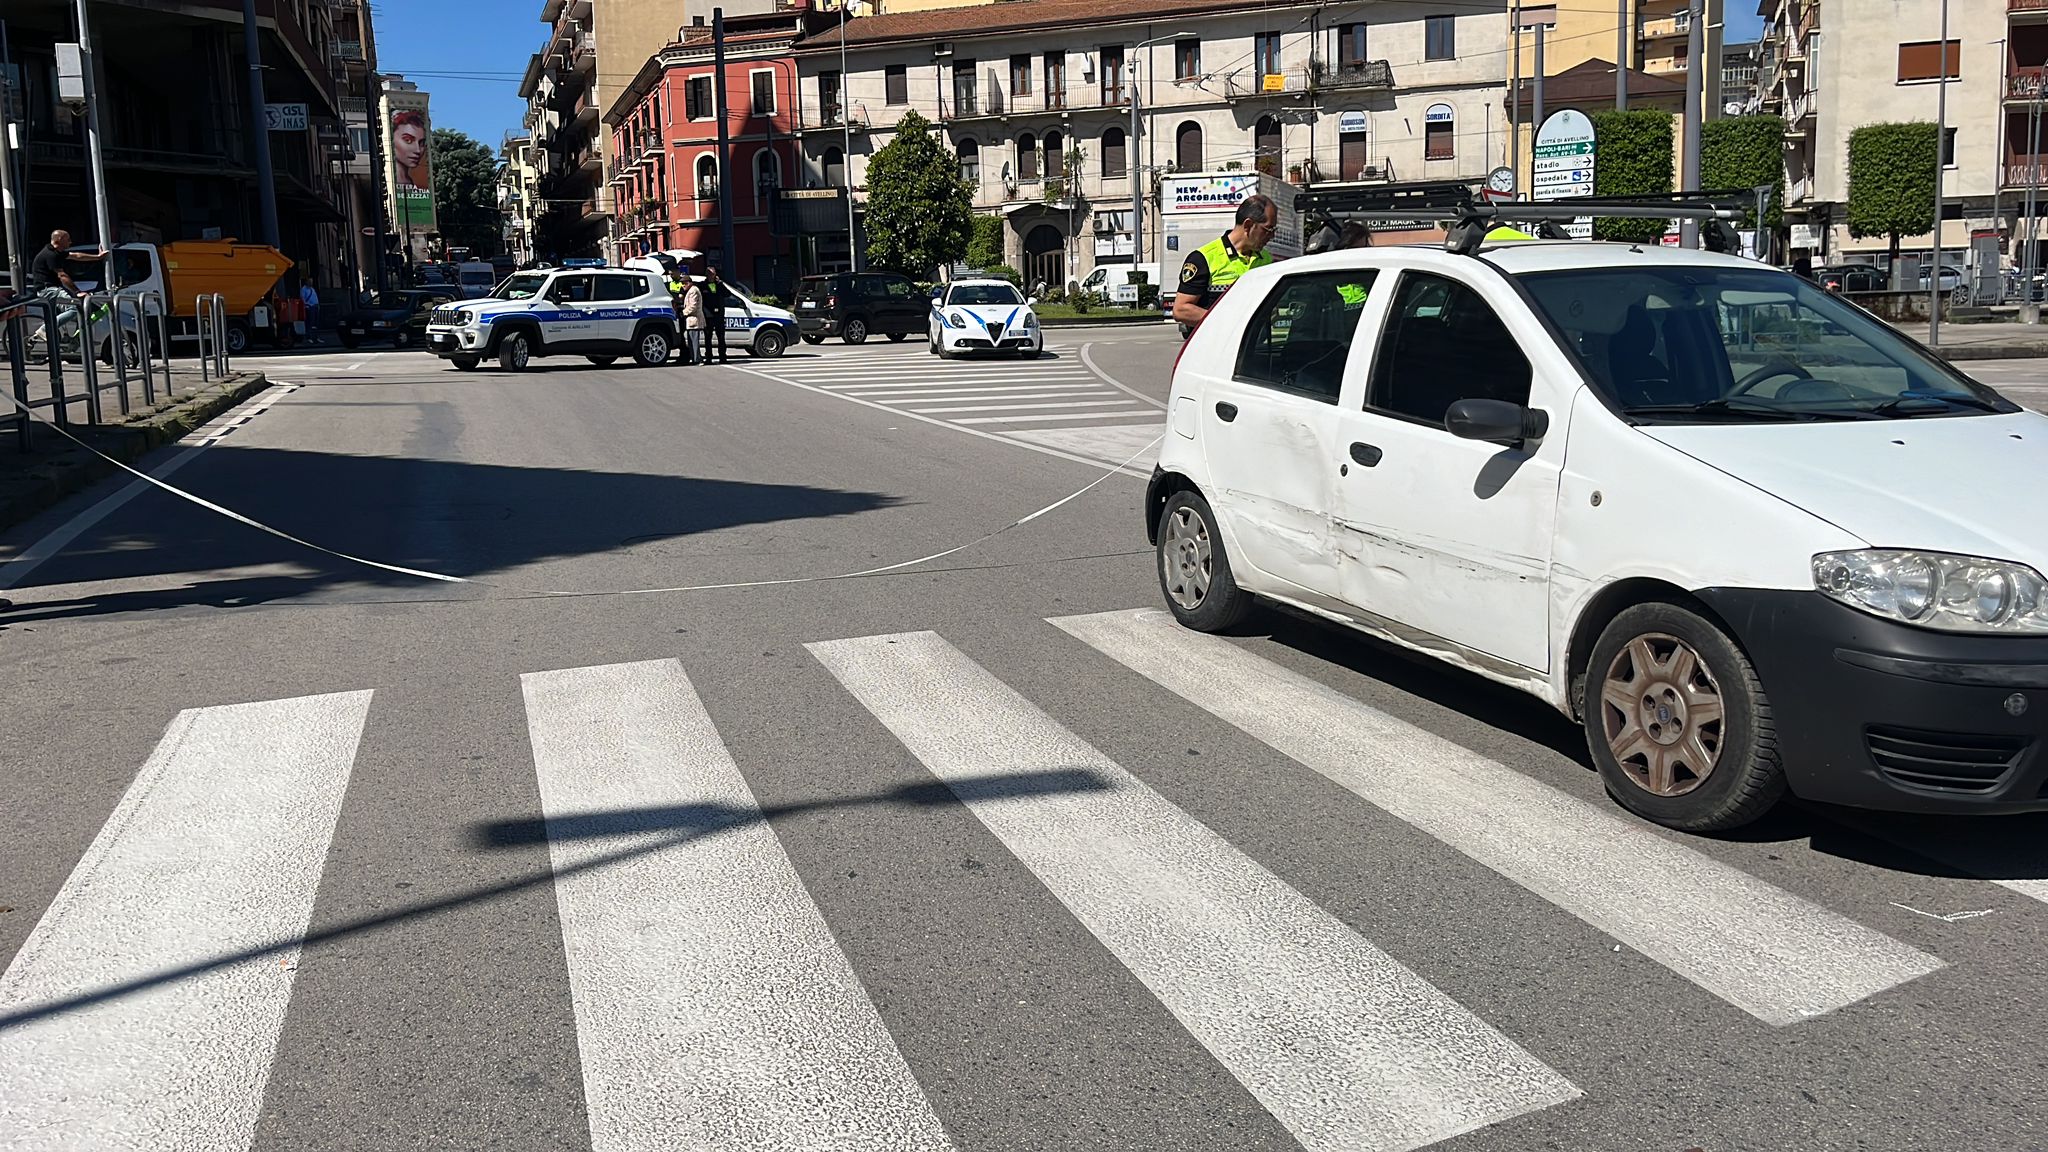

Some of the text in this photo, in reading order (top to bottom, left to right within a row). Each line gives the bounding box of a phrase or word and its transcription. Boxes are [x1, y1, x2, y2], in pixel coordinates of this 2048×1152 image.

[282, 105, 305, 116] CISL
[282, 117, 305, 129] INAS
[1563, 135, 1590, 143] AVELLINO
[1536, 161, 1560, 169] stadio
[1535, 174, 1568, 183] ospedale
[1176, 193, 1243, 202] ARCOBALENO
[600, 310, 634, 318] MUNICIPALE
